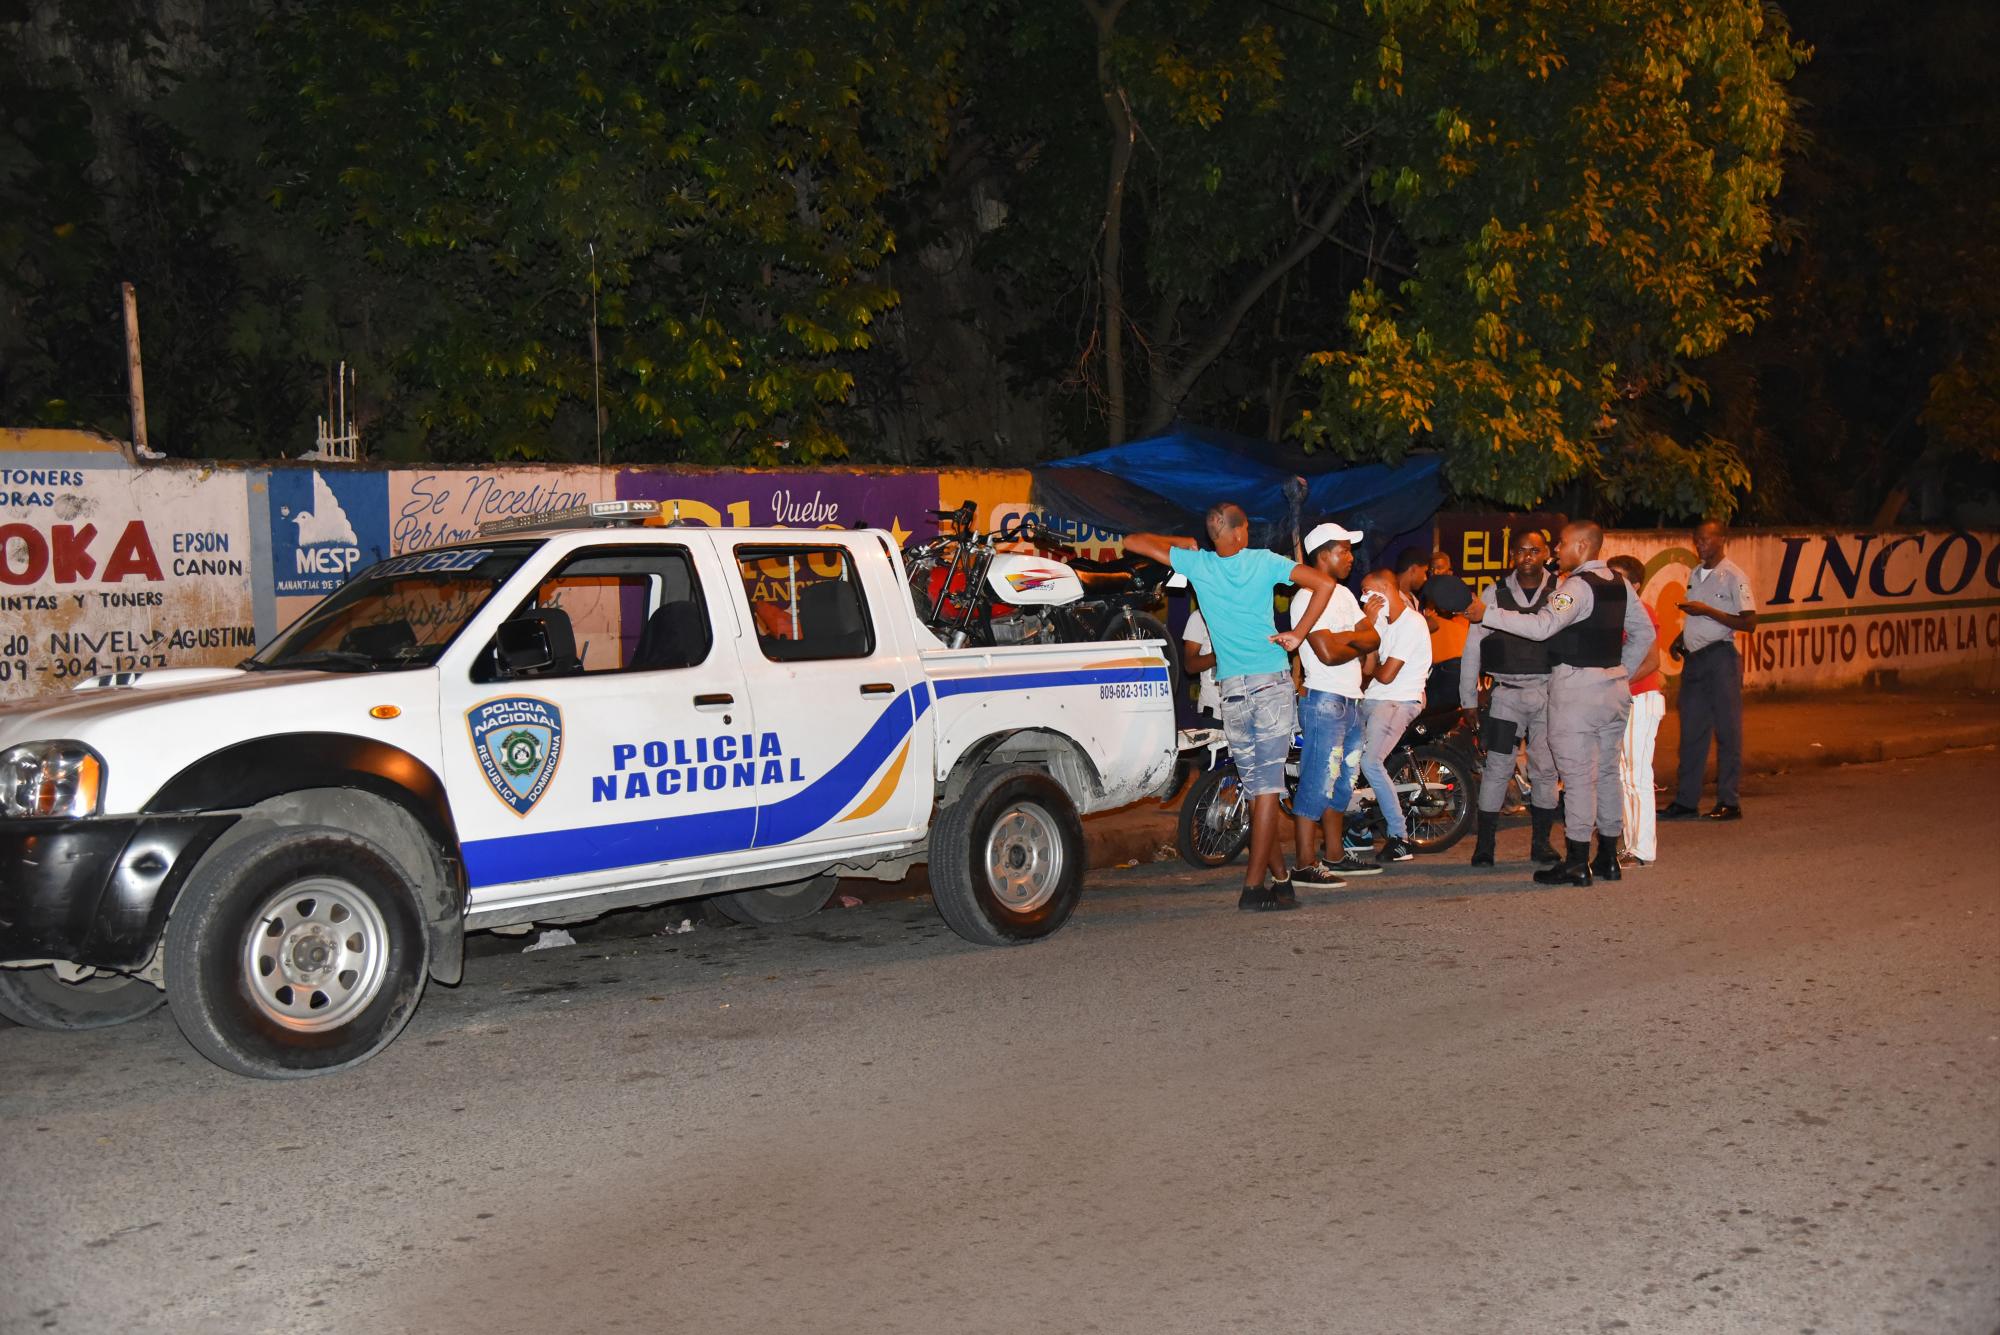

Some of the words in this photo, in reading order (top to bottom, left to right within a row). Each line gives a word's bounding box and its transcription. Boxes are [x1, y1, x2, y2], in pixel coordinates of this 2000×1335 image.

[1, 469, 84, 487] TONERS
[401, 475, 450, 517] Se
[461, 475, 587, 525] Necesitan
[771, 489, 838, 522] Vuelve
[172, 532, 229, 553] EPSON
[173, 558, 243, 577] CANON
[295, 547, 361, 574] MESP
[321, 580, 334, 590] DE
[72, 593, 86, 609] Y
[100, 591, 164, 608] TONERS
[50, 630, 139, 655] NIVEL
[167, 624, 257, 650] AGUSTINA
[1866, 616, 1948, 660] CONTRA
[1956, 613, 1978, 651] LA
[1100, 683, 1152, 700] 809-682-3151
[1159, 682, 1169, 697] 54
[481, 701, 548, 719] POLICIA
[474, 712, 561, 737] NACIONAL
[612, 731, 783, 772] POLICIA
[477, 744, 518, 806] REPUBLICA
[528, 735, 562, 802] DOMINICANA
[592, 757, 806, 803] NACIONAL
